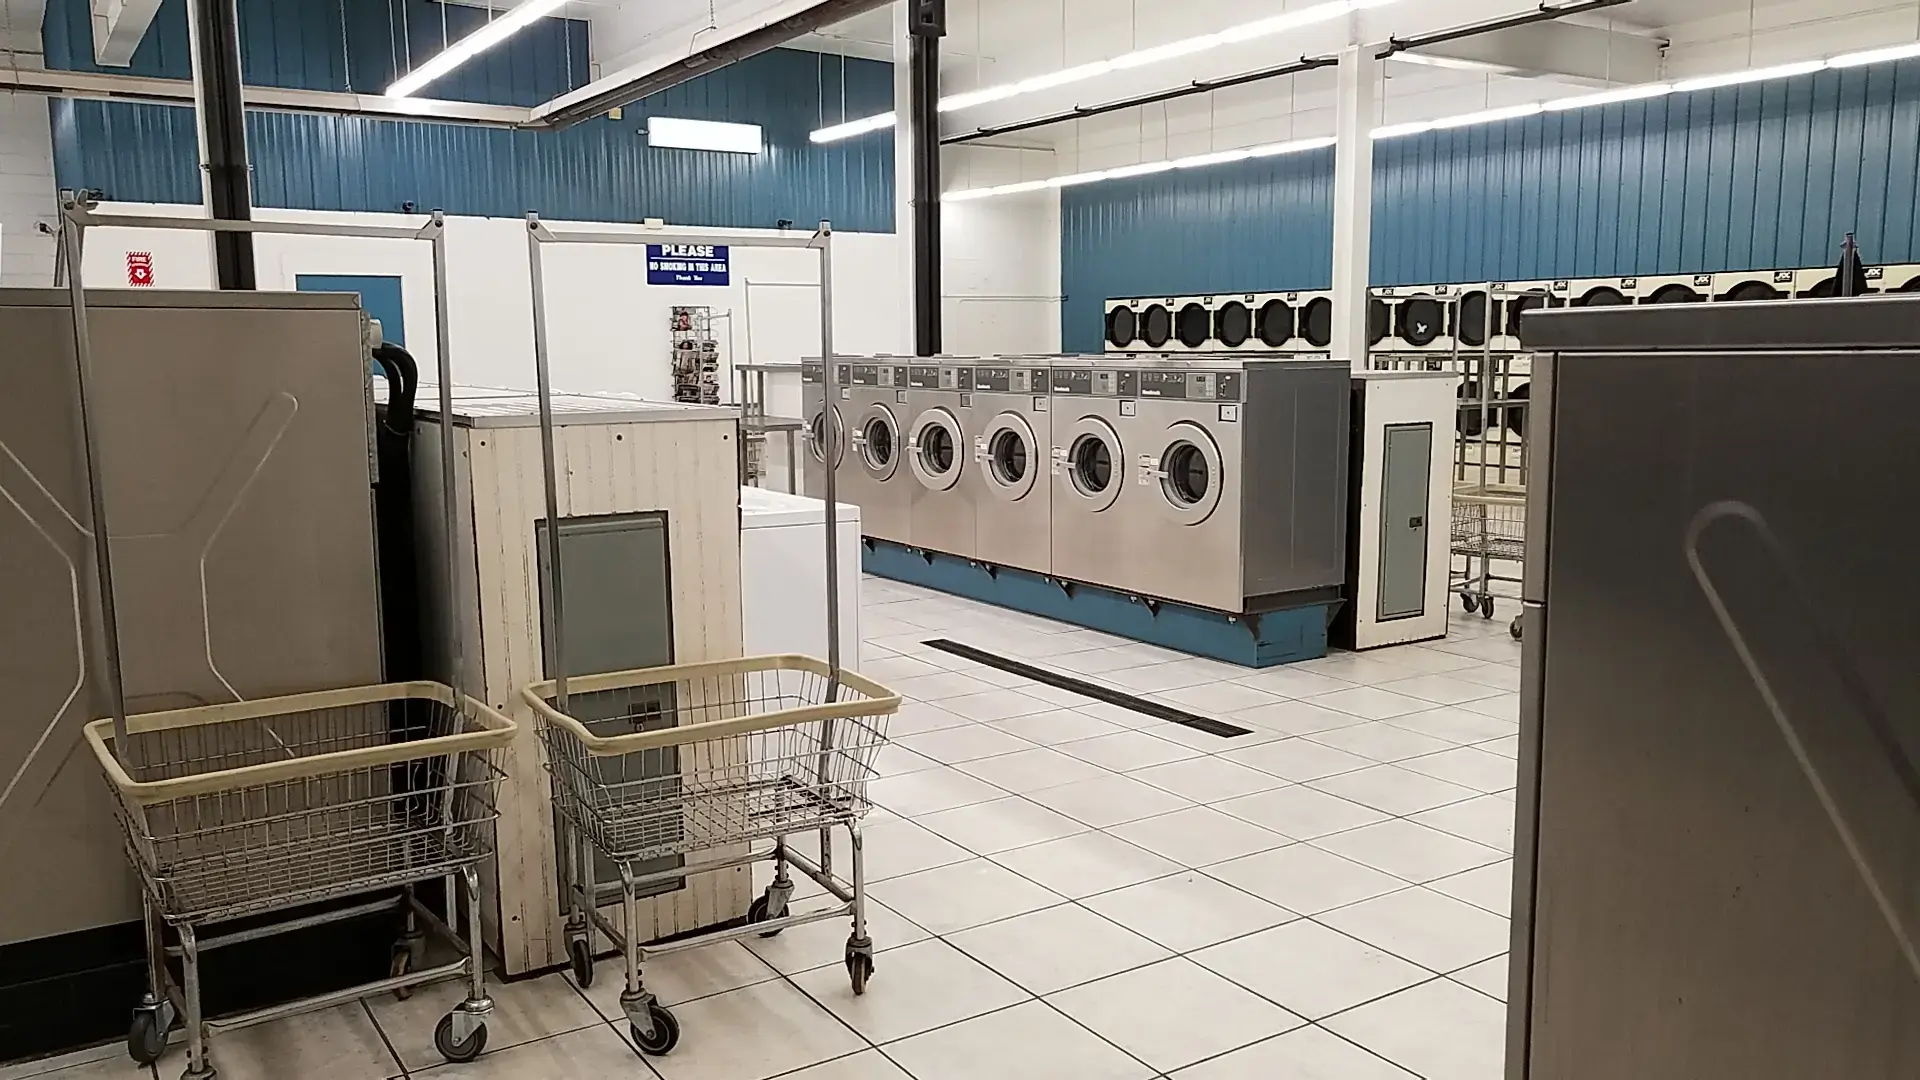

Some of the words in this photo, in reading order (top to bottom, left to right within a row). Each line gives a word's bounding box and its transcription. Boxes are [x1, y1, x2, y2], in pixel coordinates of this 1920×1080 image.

[662, 245, 714, 257] PLEASE
[649, 262, 658, 270] NO
[660, 262, 687, 271] SMOKING
[688, 263, 694, 271] IN
[695, 263, 709, 271] THIS
[711, 263, 727, 272] AREA
